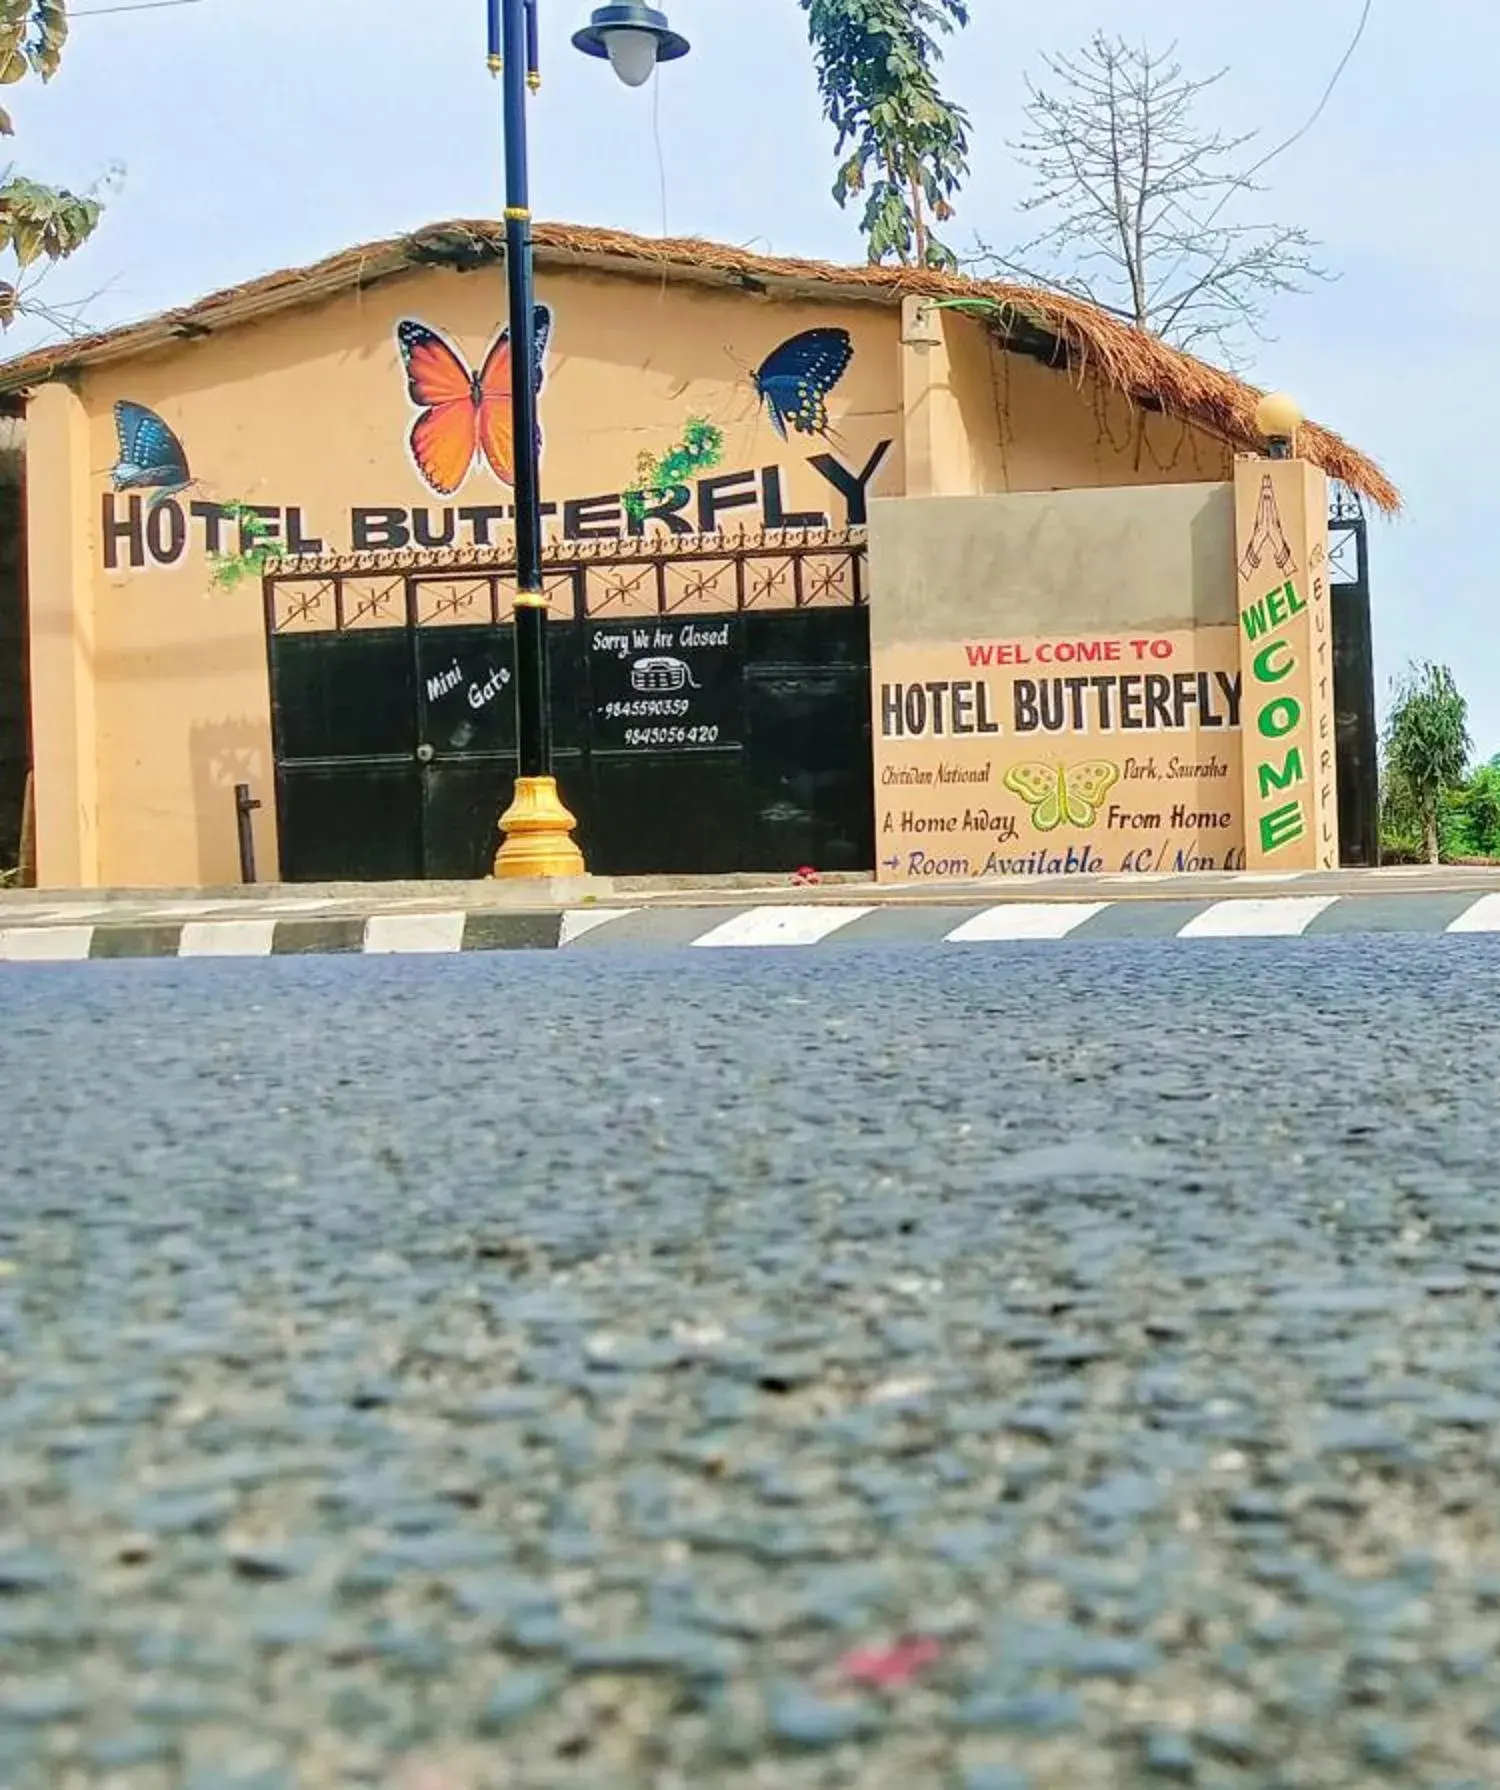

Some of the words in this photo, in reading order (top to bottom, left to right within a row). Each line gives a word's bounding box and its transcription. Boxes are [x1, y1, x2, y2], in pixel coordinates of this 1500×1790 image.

[592, 631, 630, 659] Sorry
[632, 629, 650, 649] We
[653, 628, 674, 649] Are
[679, 624, 729, 647] Closed
[965, 641, 1122, 667] WELCOME
[1130, 639, 1174, 660] TO
[427, 658, 463, 702] Mini
[468, 667, 511, 709] Gate
[881, 681, 999, 737] HOTEL
[1013, 671, 1242, 732] BUTTERFLY
[934, 761, 991, 788] National
[883, 811, 894, 834] A
[901, 811, 957, 833] Home
[961, 809, 1019, 843] Away
[1107, 804, 1161, 829] From
[1170, 804, 1232, 829] Home
[907, 850, 969, 876] Room
[981, 845, 1103, 877] Available
